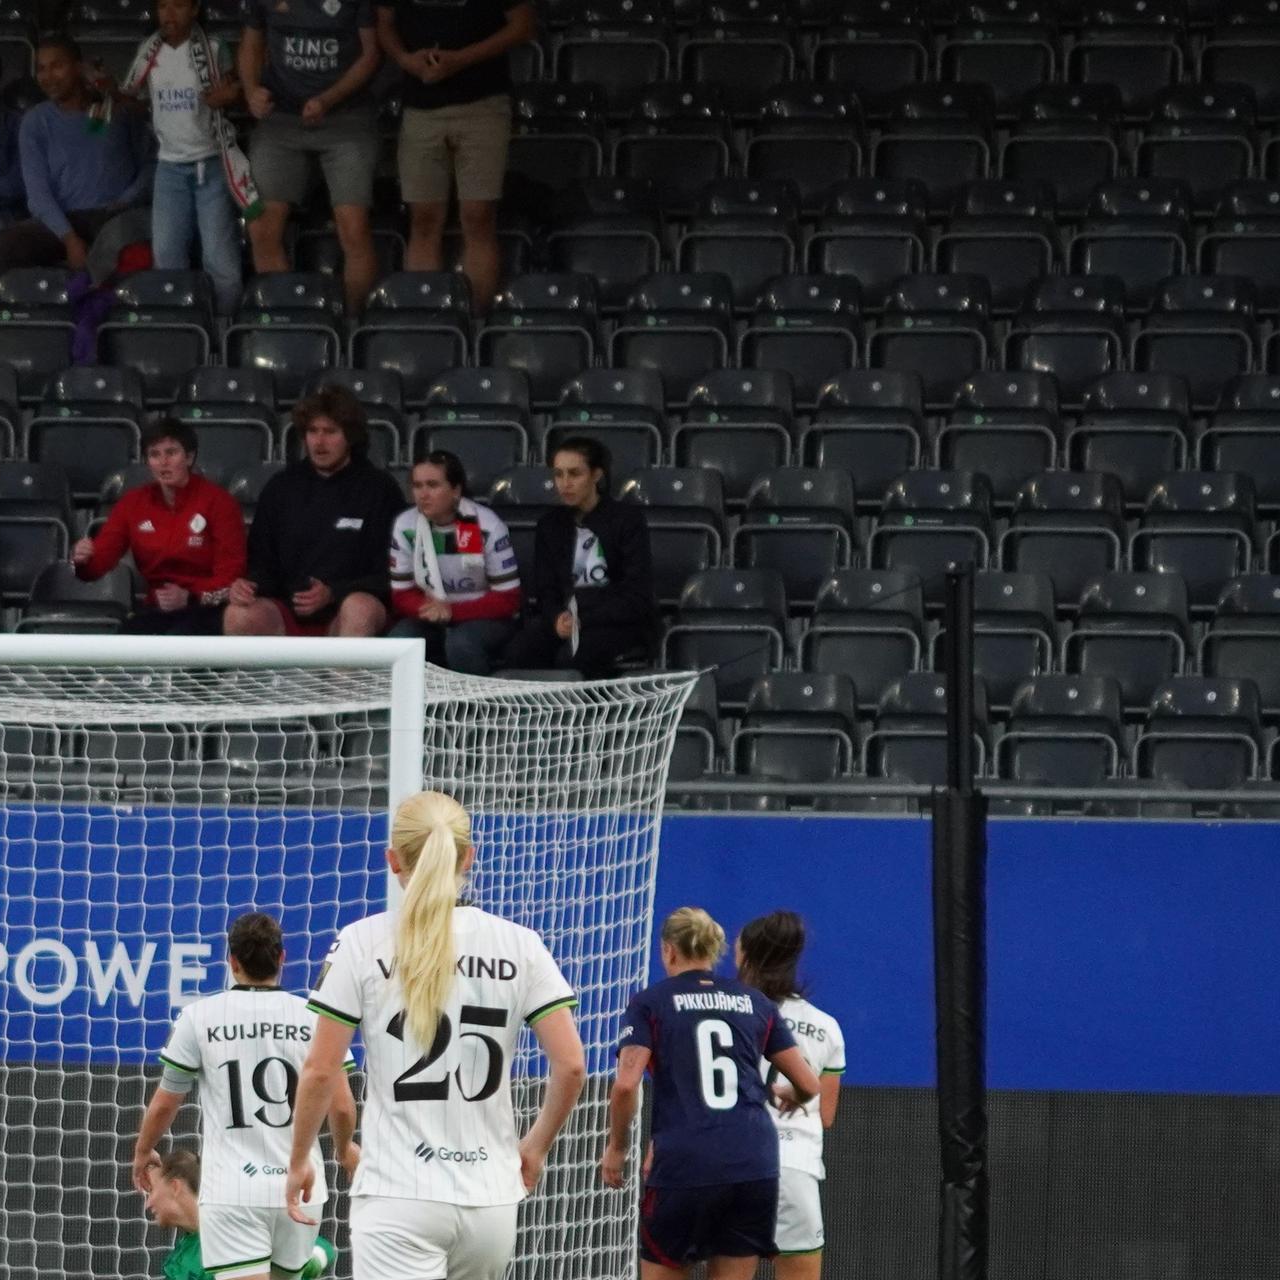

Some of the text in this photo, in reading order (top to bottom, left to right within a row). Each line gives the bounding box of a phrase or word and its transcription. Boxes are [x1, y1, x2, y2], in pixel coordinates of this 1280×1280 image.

[285, 37, 339, 55] KING
[285, 54, 338, 71] POWER
[158, 87, 195, 100] KING
[376, 954, 518, 981] VKIND
[207, 1022, 312, 1043] KUIJPERS
[386, 1005, 508, 1102] 25
[697, 1019, 739, 1110] 6
[218, 1056, 299, 1130] 19
